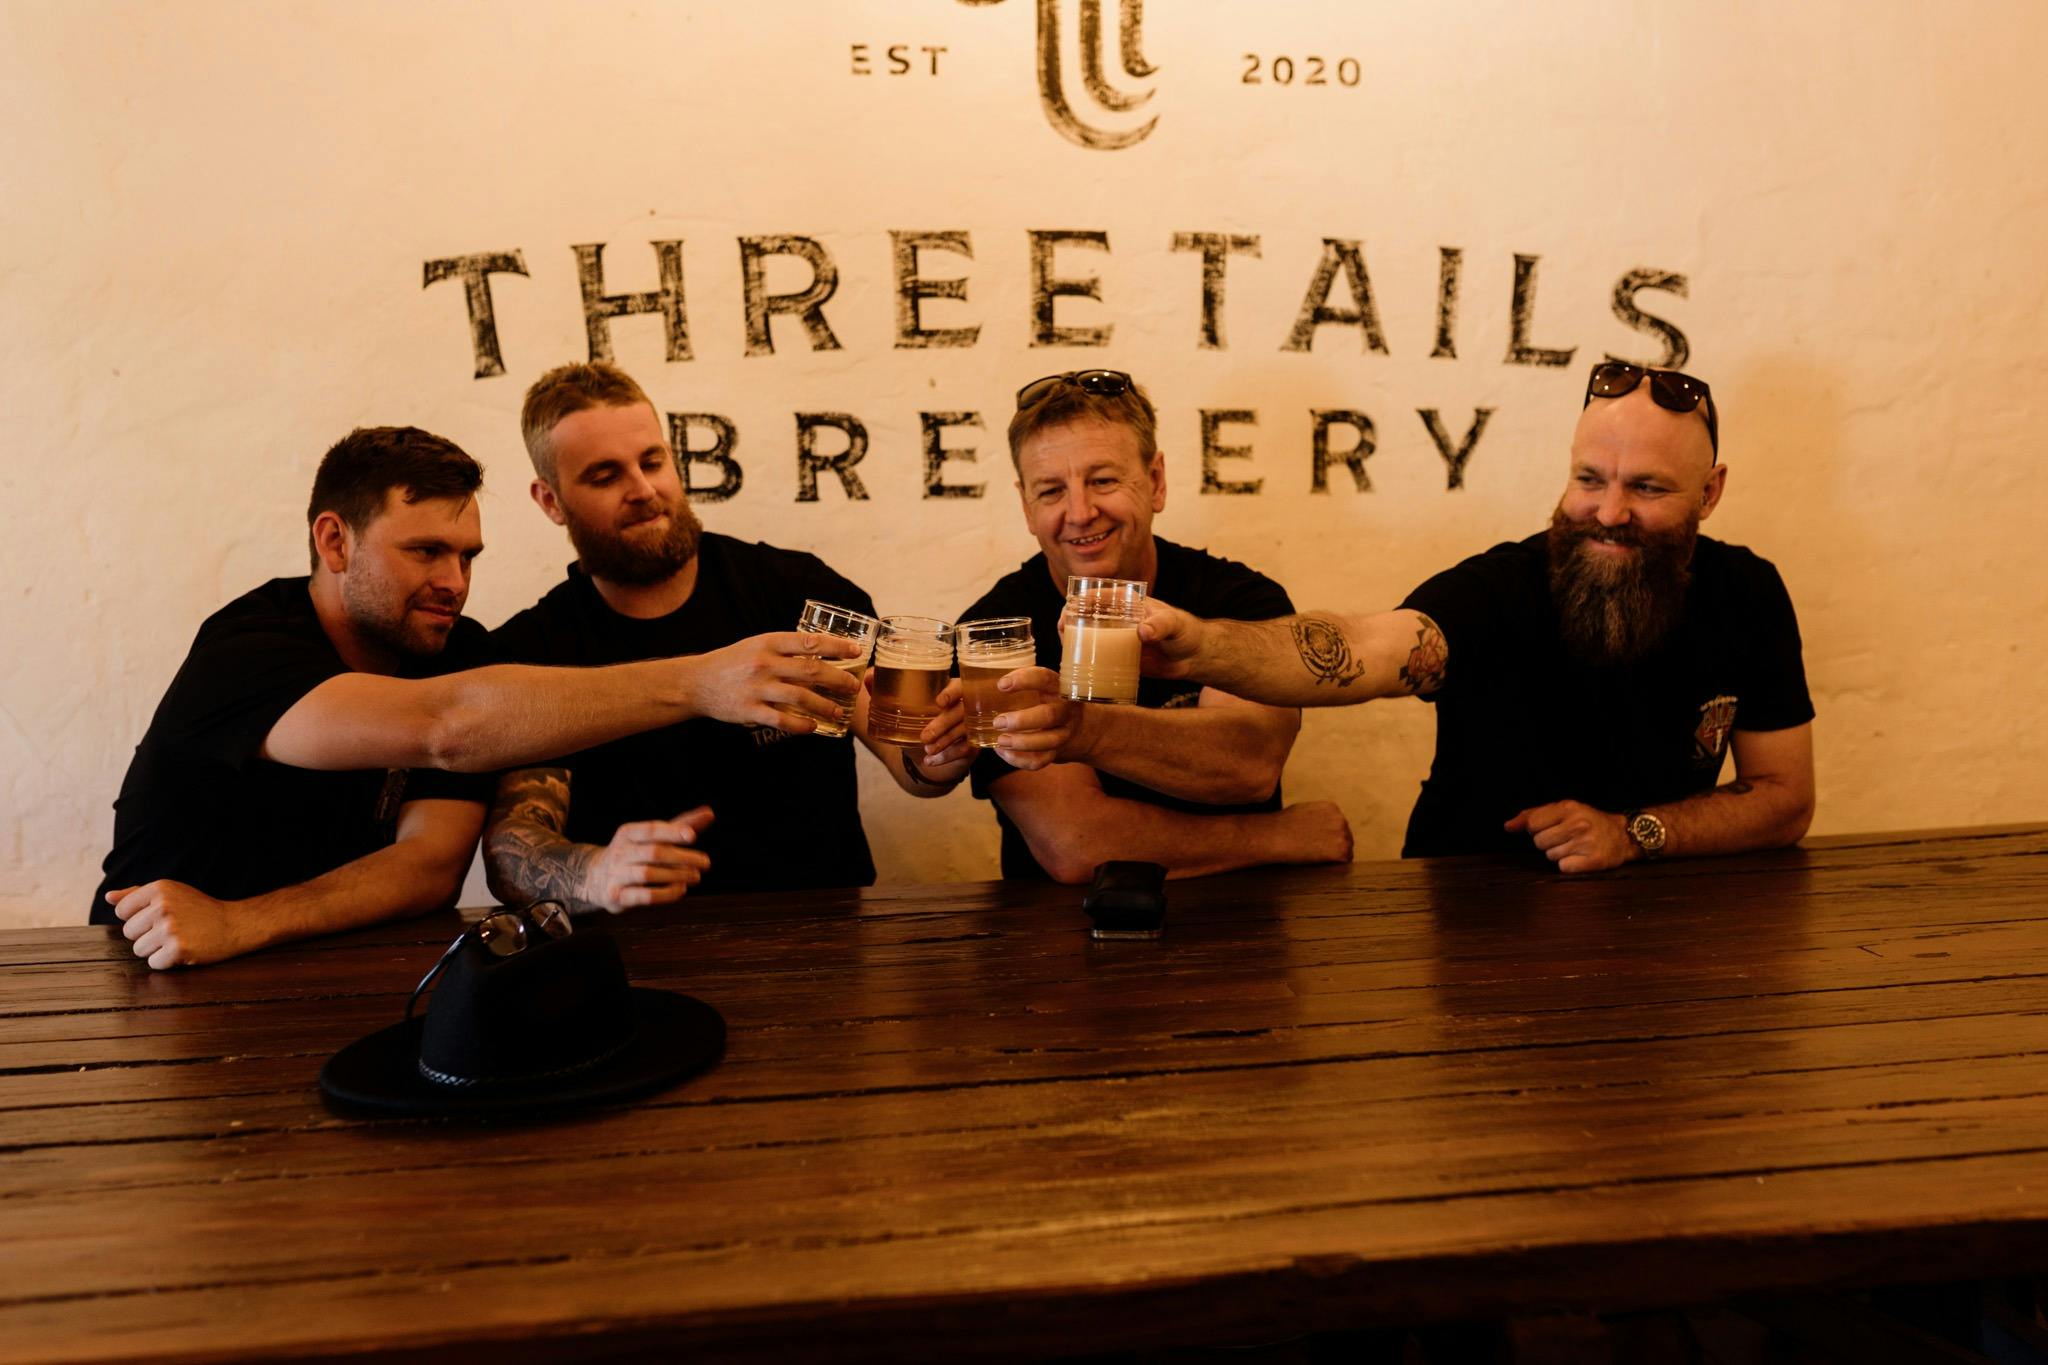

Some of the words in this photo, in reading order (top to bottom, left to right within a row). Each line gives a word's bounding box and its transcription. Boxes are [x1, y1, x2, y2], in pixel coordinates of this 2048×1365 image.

[851, 45, 947, 75] EST
[1241, 53, 1361, 86] 2020
[665, 407, 1498, 502] BREERY
